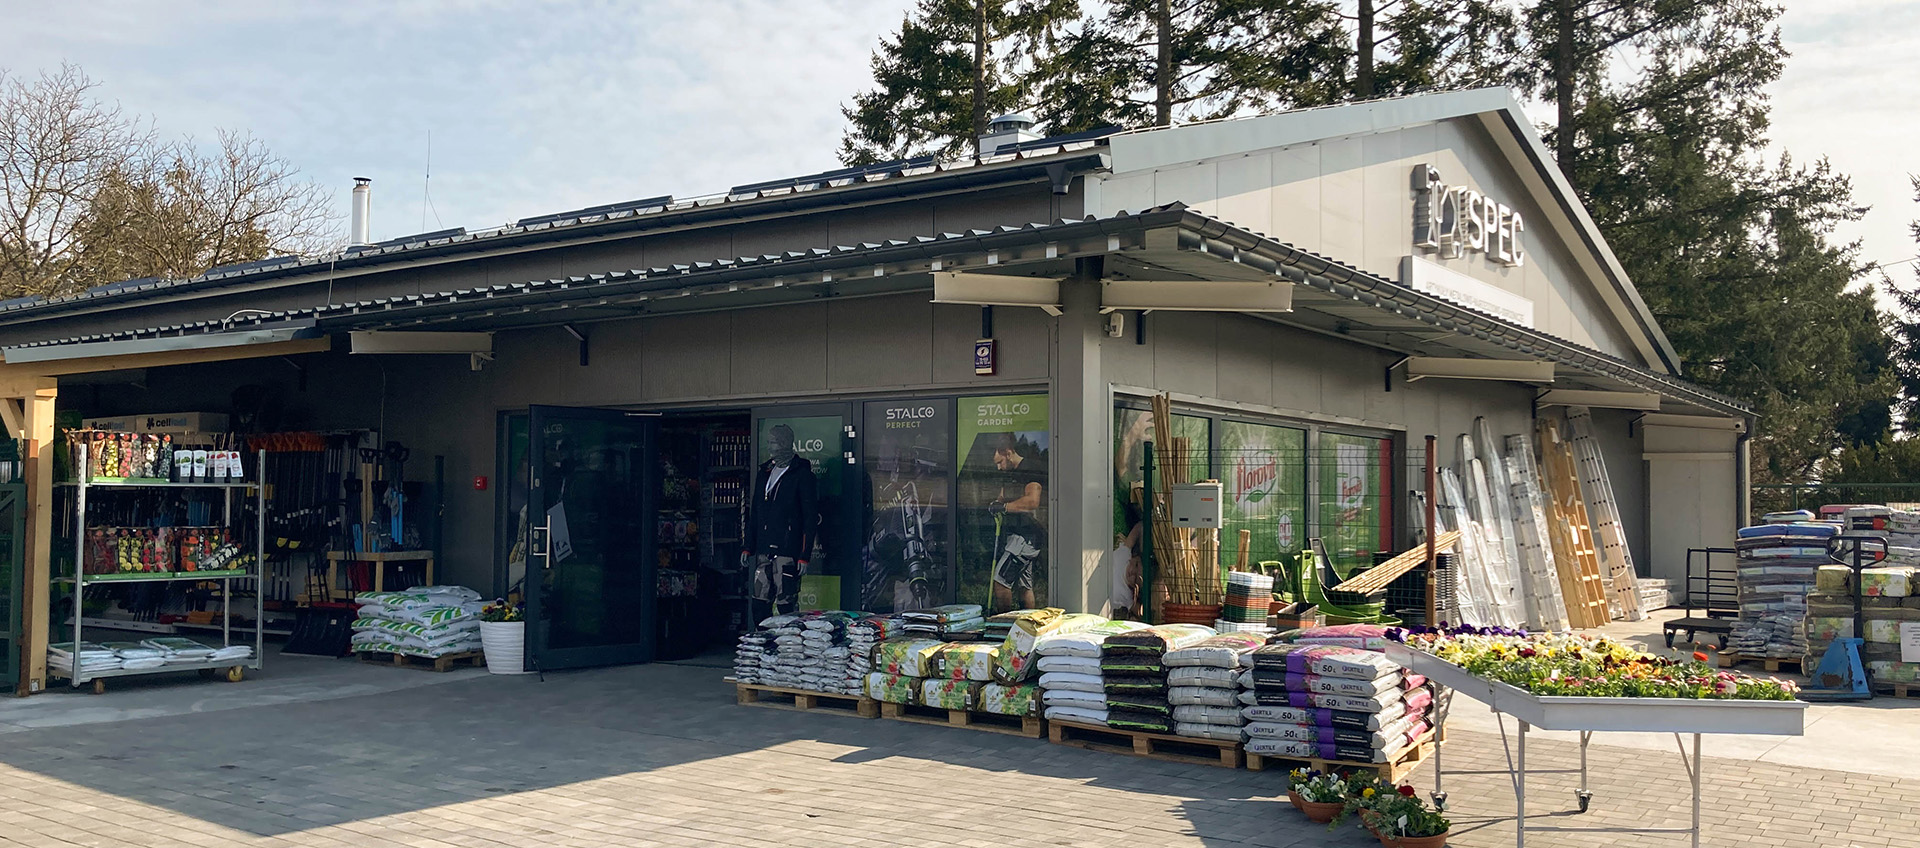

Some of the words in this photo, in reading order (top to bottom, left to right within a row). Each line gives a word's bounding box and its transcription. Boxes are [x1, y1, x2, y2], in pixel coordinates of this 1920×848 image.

[1468, 190, 1524, 267] SPEC
[886, 406, 935, 419] STALCO
[977, 403, 1030, 416] STALCO
[886, 421, 921, 429] PERFECT
[977, 418, 1013, 426] GARDEN
[792, 439, 823, 452] ALCO
[1235, 455, 1277, 503] florovit
[1321, 683, 1331, 691] 50
[1284, 730, 1294, 738] 50
